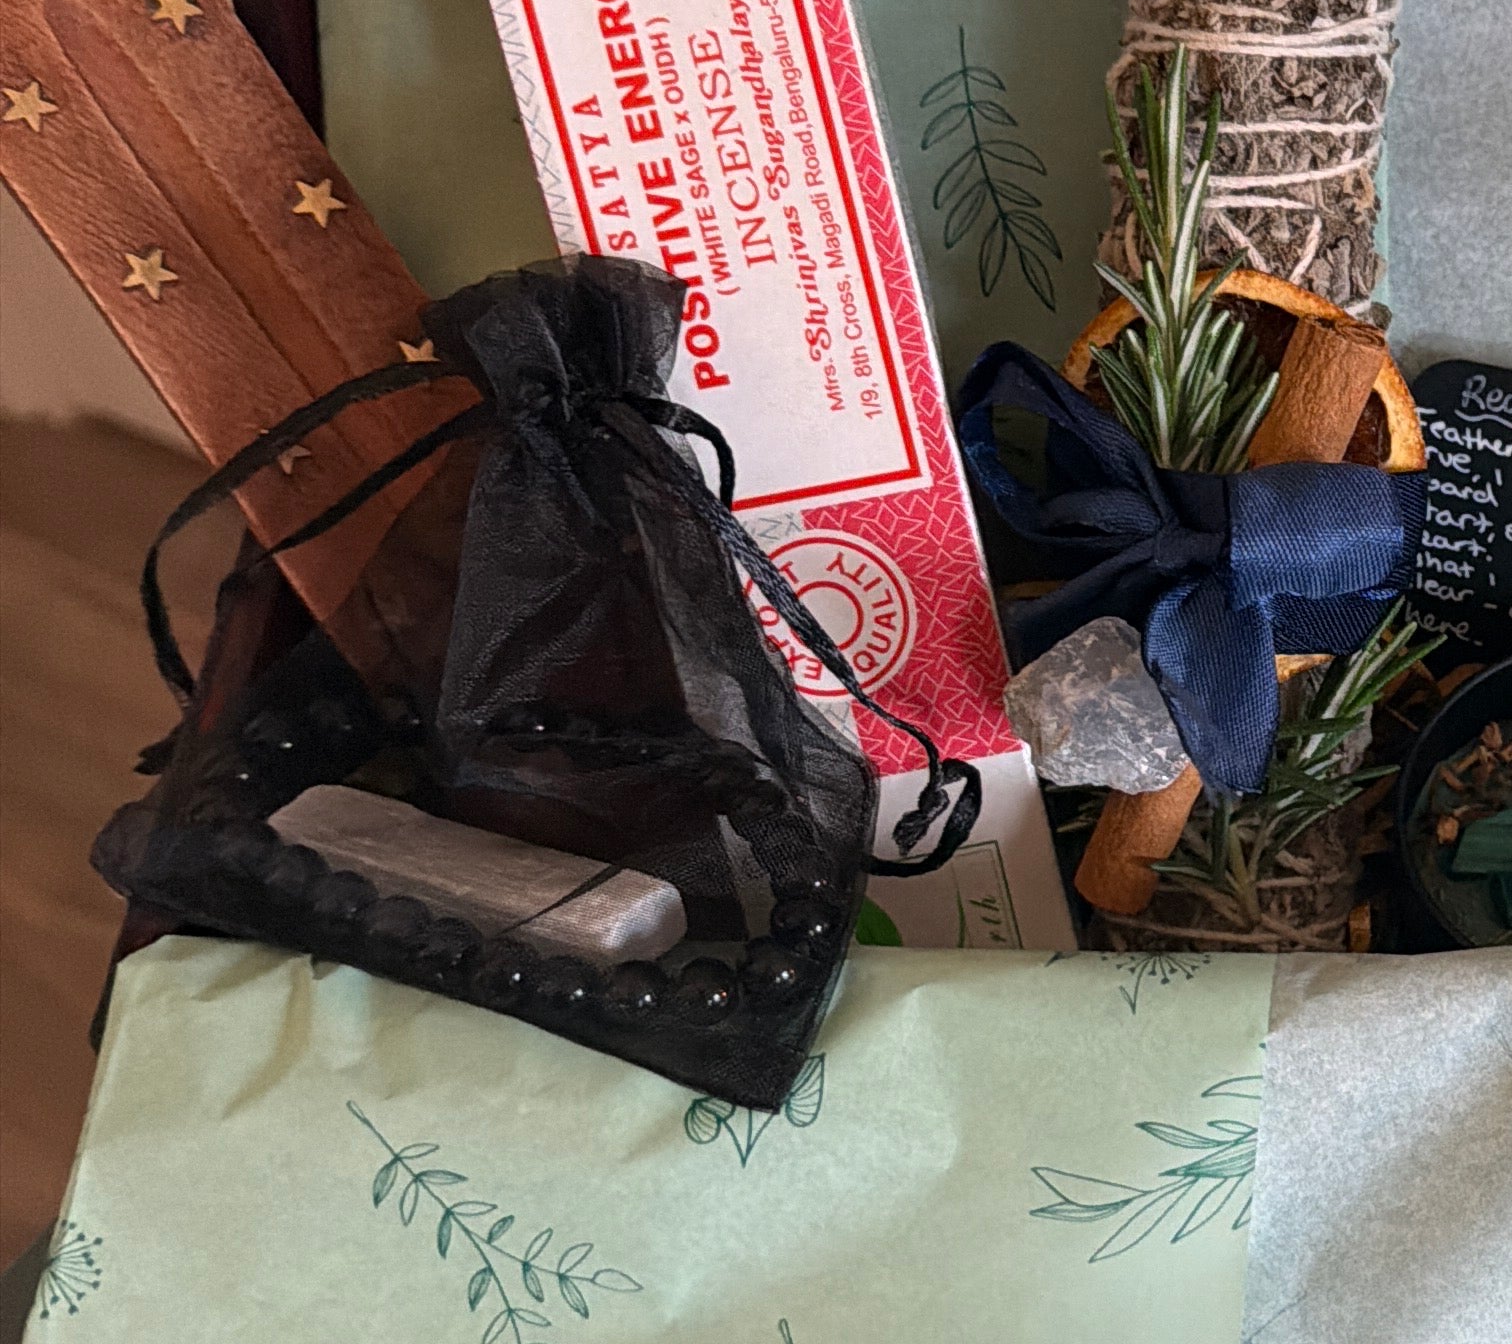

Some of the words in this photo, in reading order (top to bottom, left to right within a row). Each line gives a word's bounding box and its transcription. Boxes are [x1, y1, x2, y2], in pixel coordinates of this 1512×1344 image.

[572, 94, 638, 251] SATYA
[675, 130, 710, 199] SAGE
[688, 29, 777, 268] INCENSE
[809, 192, 846, 269] Magadi
[637, 156, 730, 390] POSITIVE
[783, 205, 832, 362] Shrinivas
[837, 274, 863, 340] Cross,
[824, 358, 845, 411] Mfrs.
[851, 345, 873, 377] 8th
[859, 382, 885, 422] 1/9,
[1425, 445, 1481, 483] rue,
[1421, 529, 1493, 562] eart.
[1426, 500, 1495, 544] tart,
[756, 560, 823, 681] EXPOT
[826, 551, 897, 673] QUALITY
[1409, 572, 1475, 601] lear
